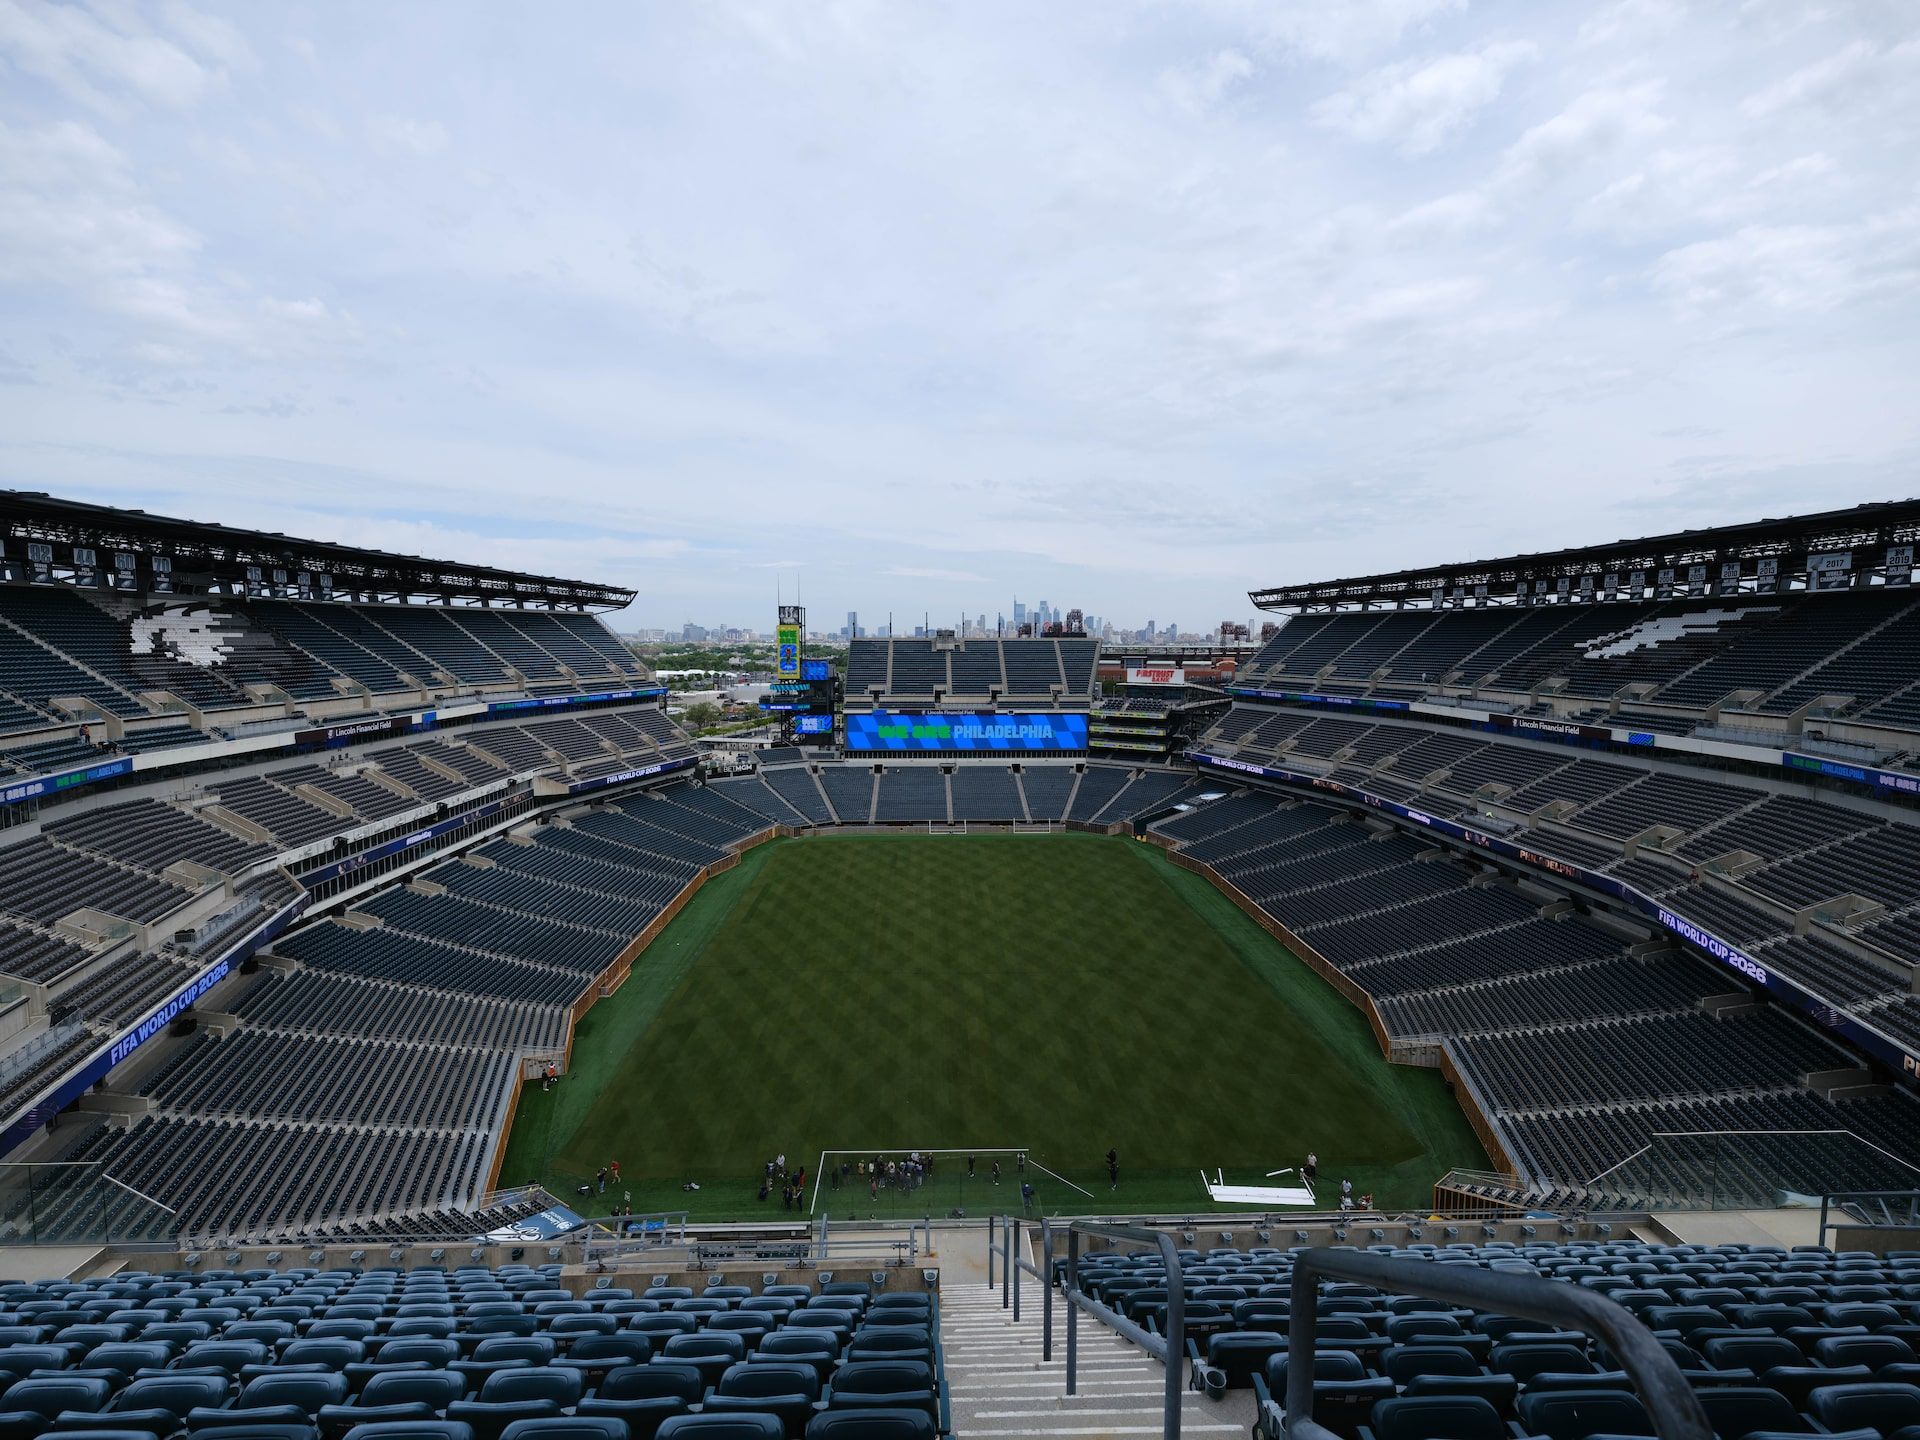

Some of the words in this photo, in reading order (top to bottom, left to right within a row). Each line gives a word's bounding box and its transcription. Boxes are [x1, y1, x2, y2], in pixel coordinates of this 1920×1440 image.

[77, 549, 94, 567] 44
[117, 554, 135, 570] 60
[154, 558, 171, 573] 70
[1826, 559, 1844, 568] 2017
[1889, 555, 1910, 565] 2019
[1760, 567, 1775, 575] 2013
[1136, 670, 1174, 678] FIRSTRUST
[336, 728, 356, 737] Lincoln
[357, 723, 379, 734] Financial
[380, 720, 391, 729] Field
[878, 725, 908, 739] WE
[912, 725, 950, 739] ARE
[954, 725, 1053, 738] PHILADELPHIA
[1519, 719, 1538, 729] Lincoln
[1539, 722, 1564, 733] Financial
[1565, 725, 1579, 735] Field
[87, 763, 123, 780] PHILADELPHIA
[723, 764, 752, 773] BETMGM
[1211, 758, 1221, 766] FIFA
[1220, 760, 1237, 769] WORLD
[1237, 763, 1246, 771] CUP
[1246, 766, 1263, 774] 2026
[1821, 763, 1864, 780] PHILADELPHIA
[606, 776, 618, 784] FIFA
[618, 772, 636, 783] WORLD
[636, 769, 645, 778] CUP
[645, 765, 661, 776] 2026
[1880, 775, 1895, 787] WE
[1896, 779, 1917, 792] ARE
[1659, 909, 1675, 930] FIFA
[1676, 919, 1708, 948] WORLD
[1709, 939, 1728, 959] CUP
[1729, 951, 1767, 984] 2026
[110, 1033, 138, 1066] FIFA
[138, 1001, 177, 1042] WORLD
[178, 984, 198, 1010] CUP
[198, 960, 229, 993] 2026
